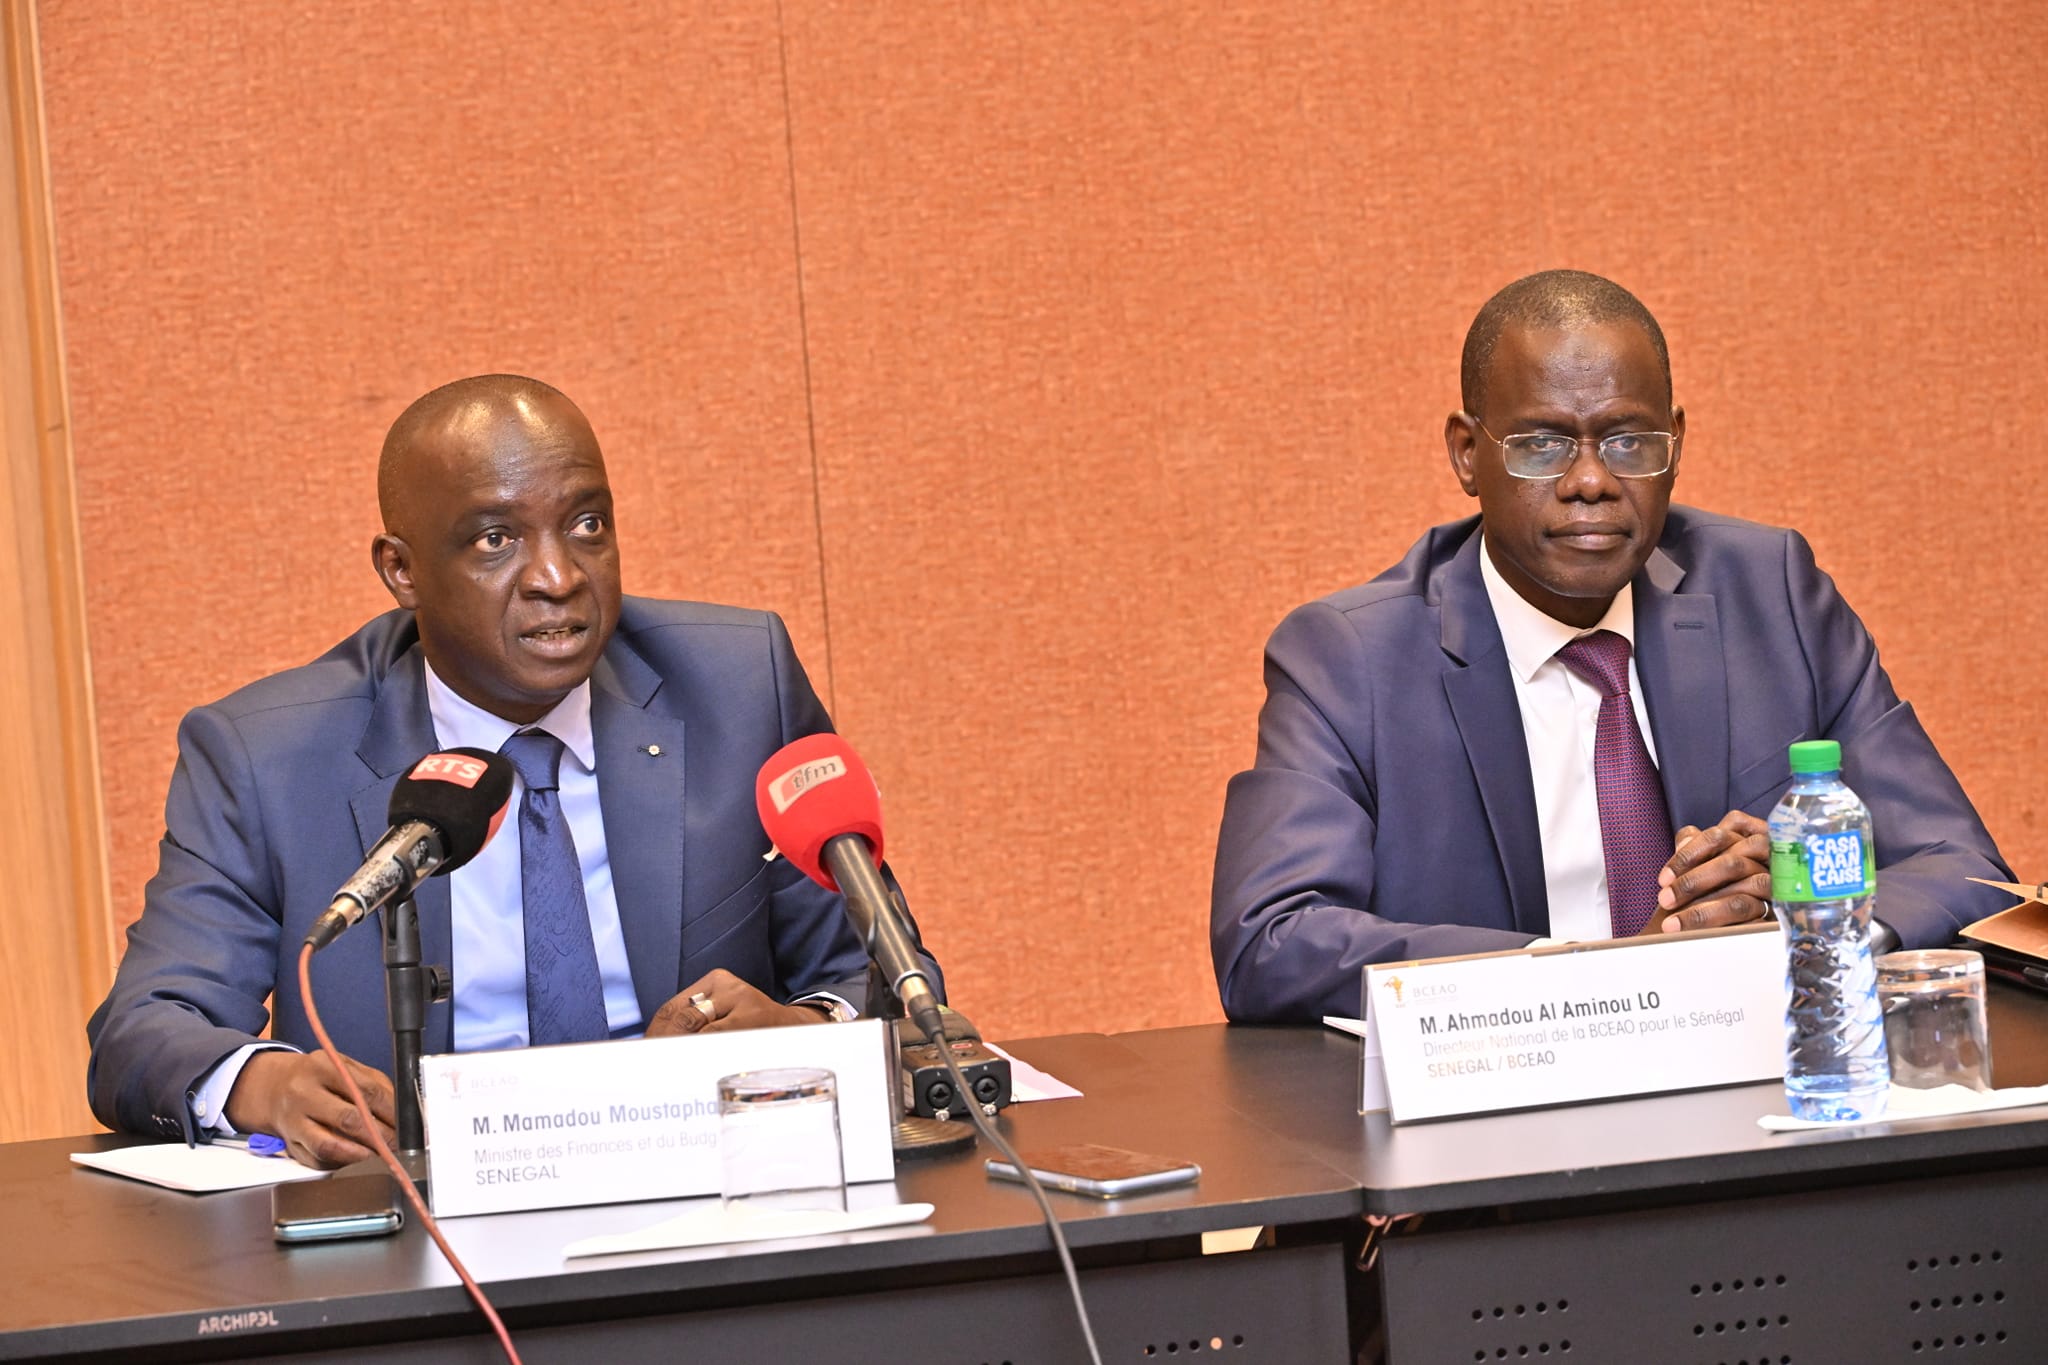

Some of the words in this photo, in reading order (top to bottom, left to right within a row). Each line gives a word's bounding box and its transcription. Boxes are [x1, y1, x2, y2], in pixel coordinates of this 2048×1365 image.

[413, 758, 481, 780] RTS
[1811, 835, 1860, 856] CASA
[1813, 851, 1860, 872] MAN
[1413, 983, 1457, 998] BCEAO
[1420, 1016, 1444, 1035] M.
[1447, 1007, 1534, 1032] Ahmadou
[1539, 1001, 1558, 1021] Al
[1562, 997, 1632, 1019] Aminou
[1637, 991, 1661, 1011] LO
[1423, 1038, 1487, 1057] Directeur
[1489, 1028, 1548, 1049] National
[1551, 1028, 1569, 1042] de
[1571, 1025, 1586, 1040] la
[1588, 1018, 1636, 1038] BCEAO
[1639, 1017, 1670, 1036] pour
[1672, 1014, 1687, 1029] le
[1689, 1007, 1745, 1027] Sénégal
[1427, 1059, 1494, 1079] SENEGAL
[1507, 1050, 1556, 1070] BCEAO
[472, 1116, 497, 1135] M.
[503, 1108, 601, 1133] Mamadou
[609, 1099, 719, 1124] Moustapha
[474, 1146, 533, 1164] Ministre
[537, 1144, 563, 1160] des
[567, 1137, 633, 1157] Finances
[638, 1137, 651, 1150] et
[656, 1133, 675, 1149] du
[680, 1131, 717, 1147] Budg
[476, 1164, 561, 1186] SENEGAL
